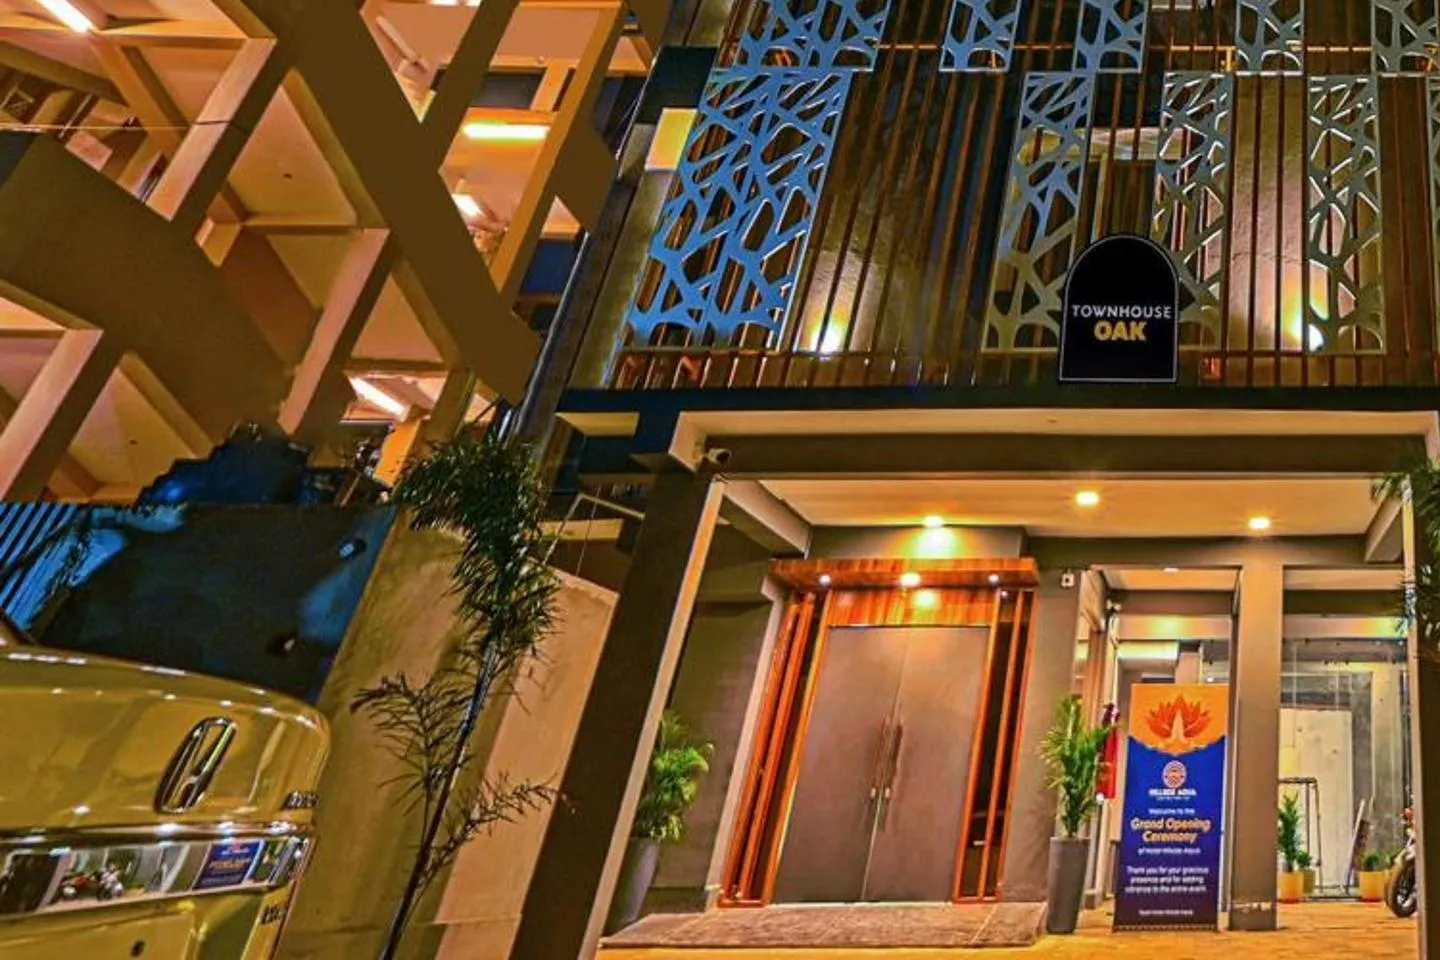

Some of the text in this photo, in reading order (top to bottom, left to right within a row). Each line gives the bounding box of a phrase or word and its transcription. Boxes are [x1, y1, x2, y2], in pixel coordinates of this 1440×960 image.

[1072, 304, 1172, 319] TOWNHOUSE
[1094, 320, 1147, 341] OAK
[1130, 817, 1212, 833] Grand Opening
[1142, 830, 1198, 844] Ceremony
